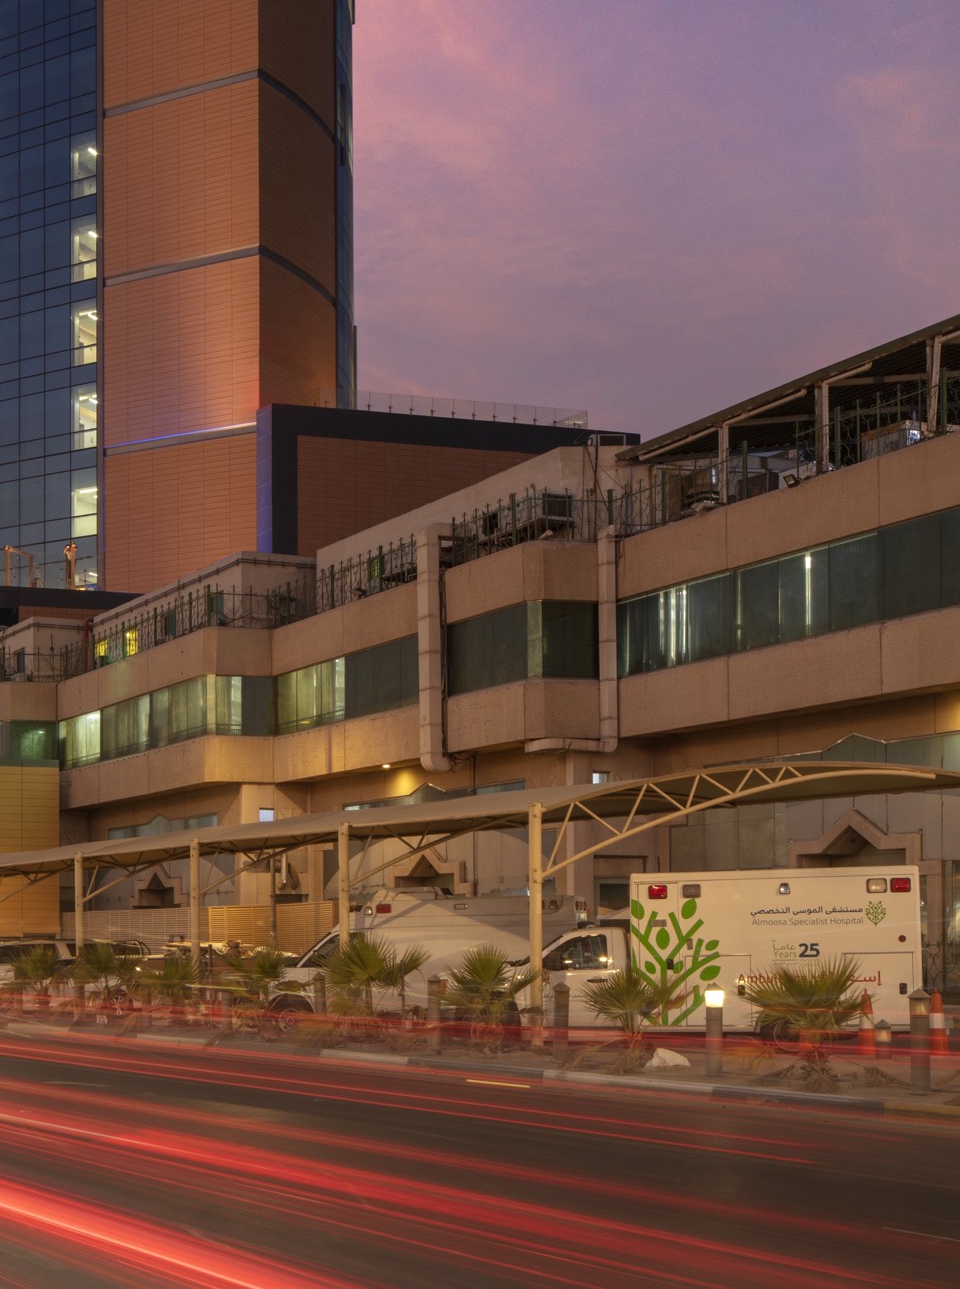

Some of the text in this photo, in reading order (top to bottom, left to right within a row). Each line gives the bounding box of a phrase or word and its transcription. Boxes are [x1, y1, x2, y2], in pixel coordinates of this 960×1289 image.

[750, 905, 863, 918] مستشفى الموسى التخصصي
[751, 917, 864, 926] Almoosa Specialist Hospital
[798, 942, 820, 958] 25
